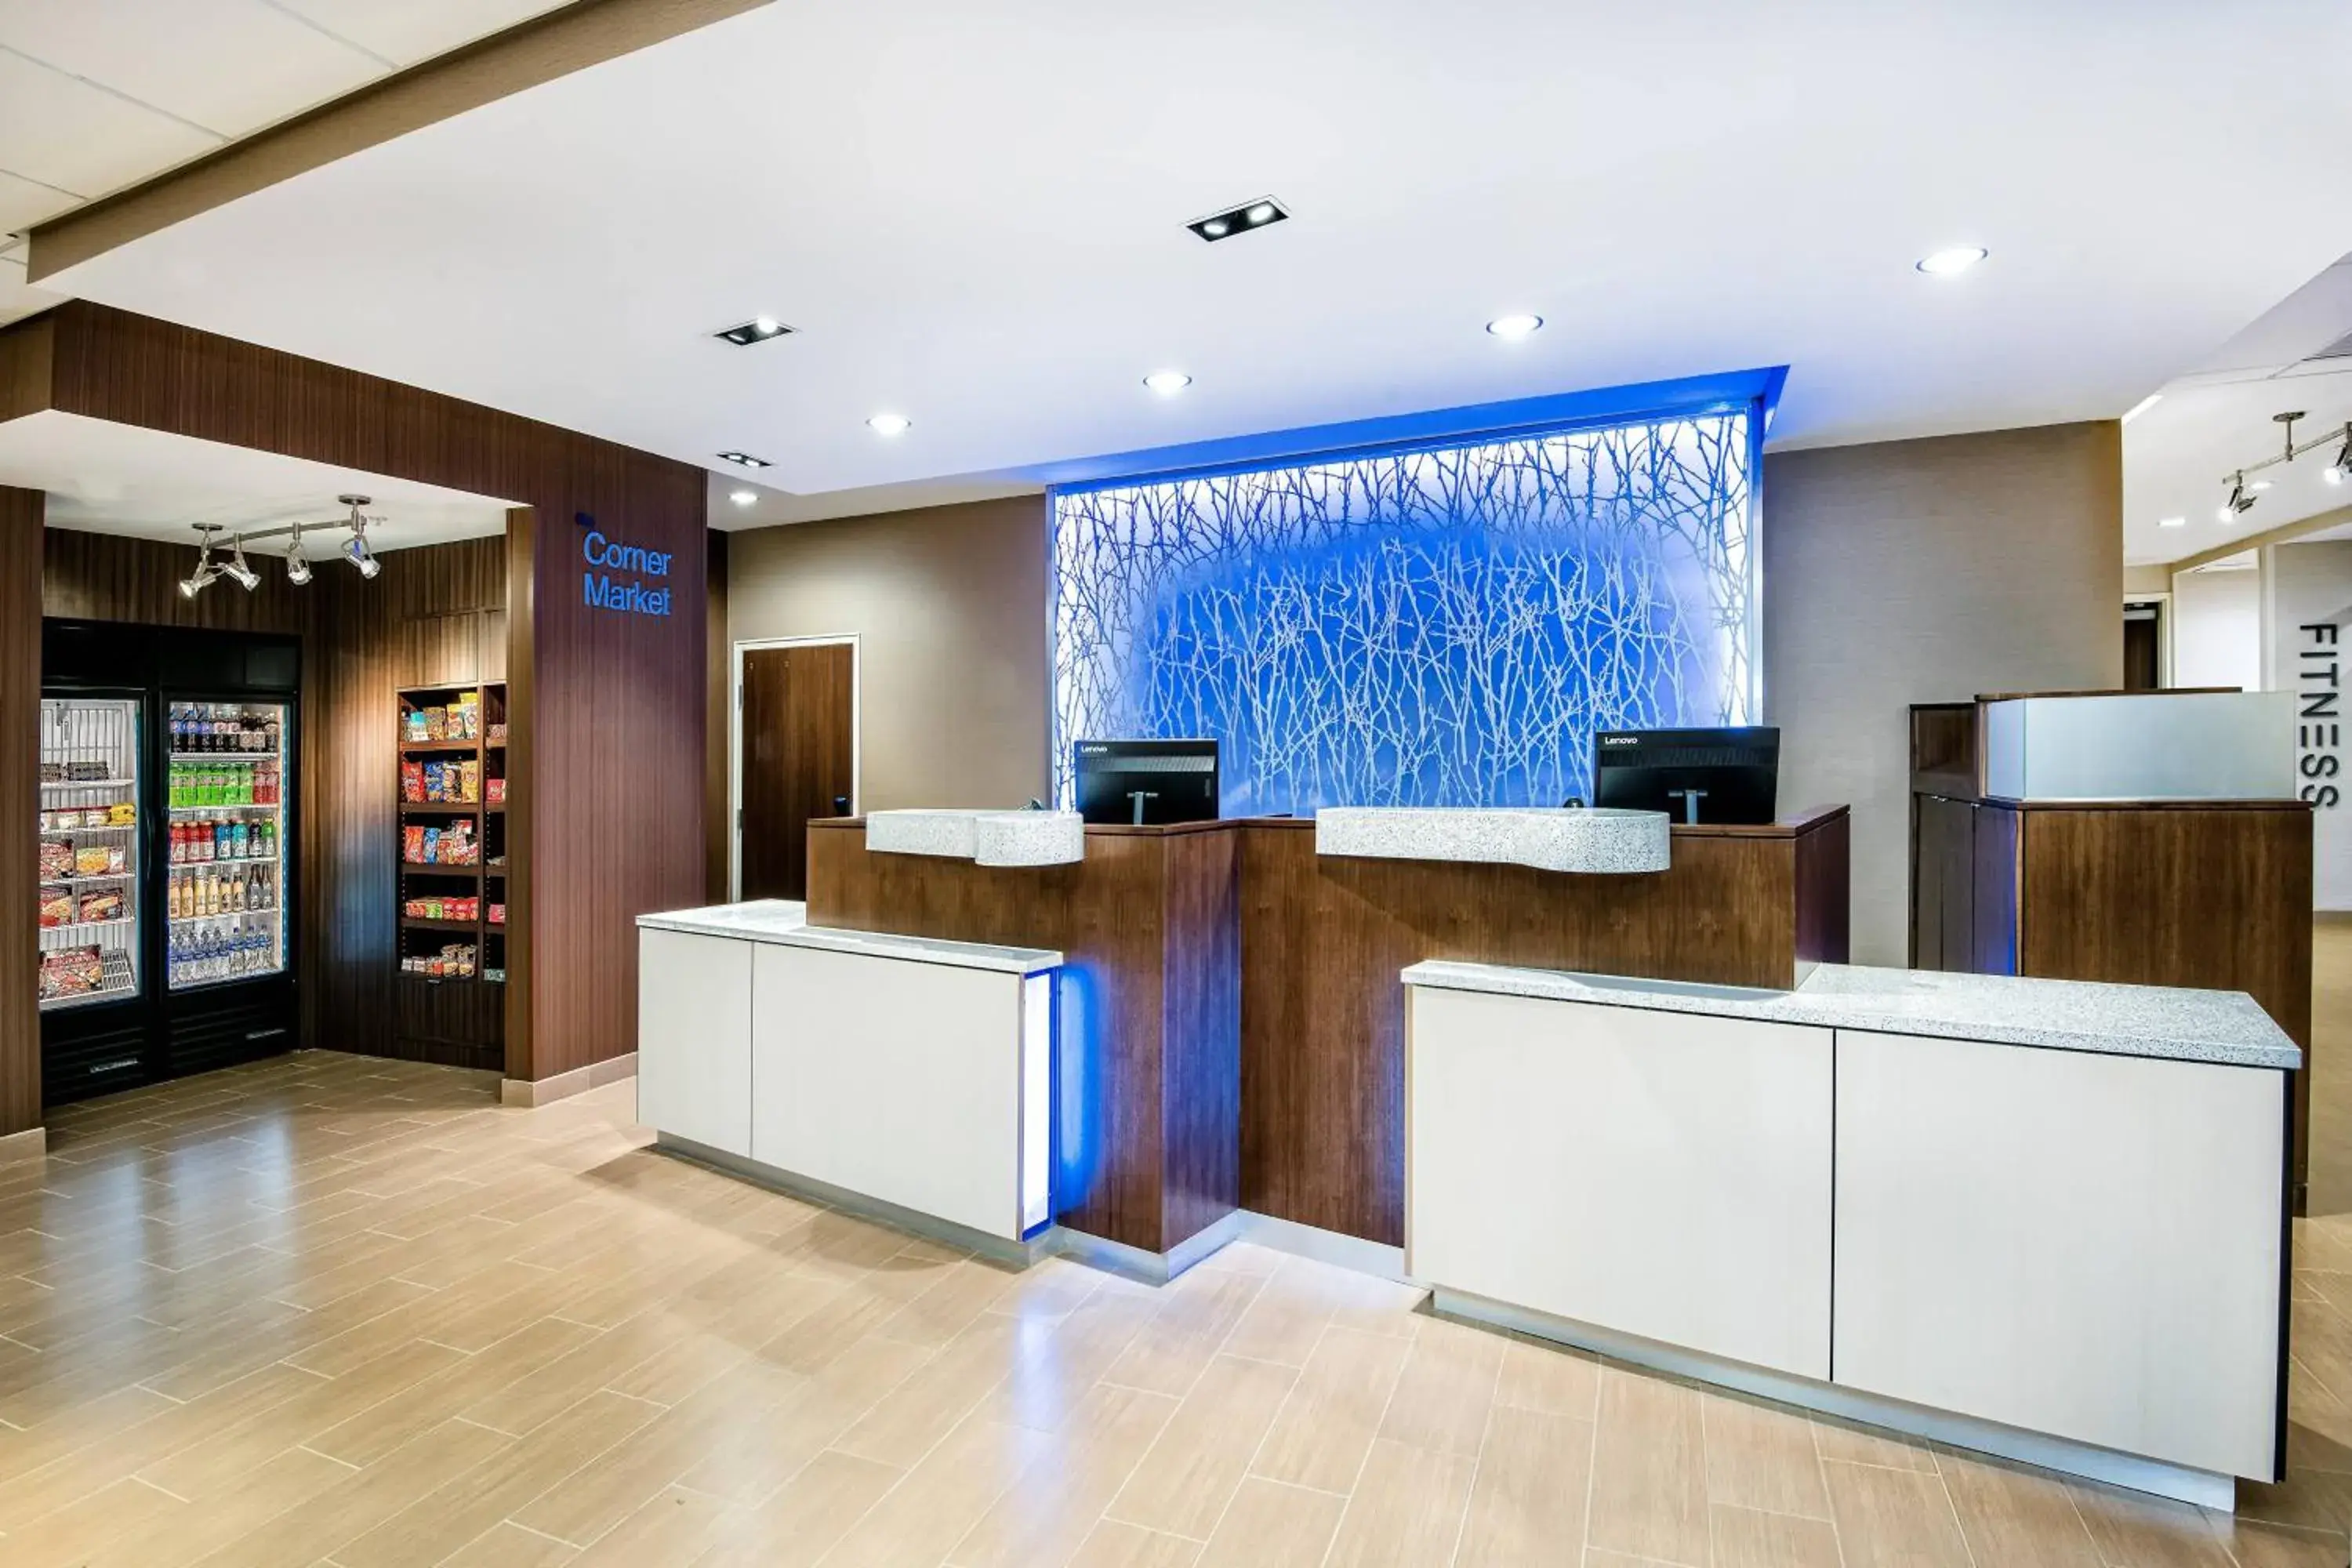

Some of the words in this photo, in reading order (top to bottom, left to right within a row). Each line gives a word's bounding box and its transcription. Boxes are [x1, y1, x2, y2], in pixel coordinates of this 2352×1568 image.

[583, 531, 672, 575] Corner
[583, 572, 671, 615] Market
[2299, 623, 2339, 808] FITNESS
[1605, 736, 1638, 745] Lenovo
